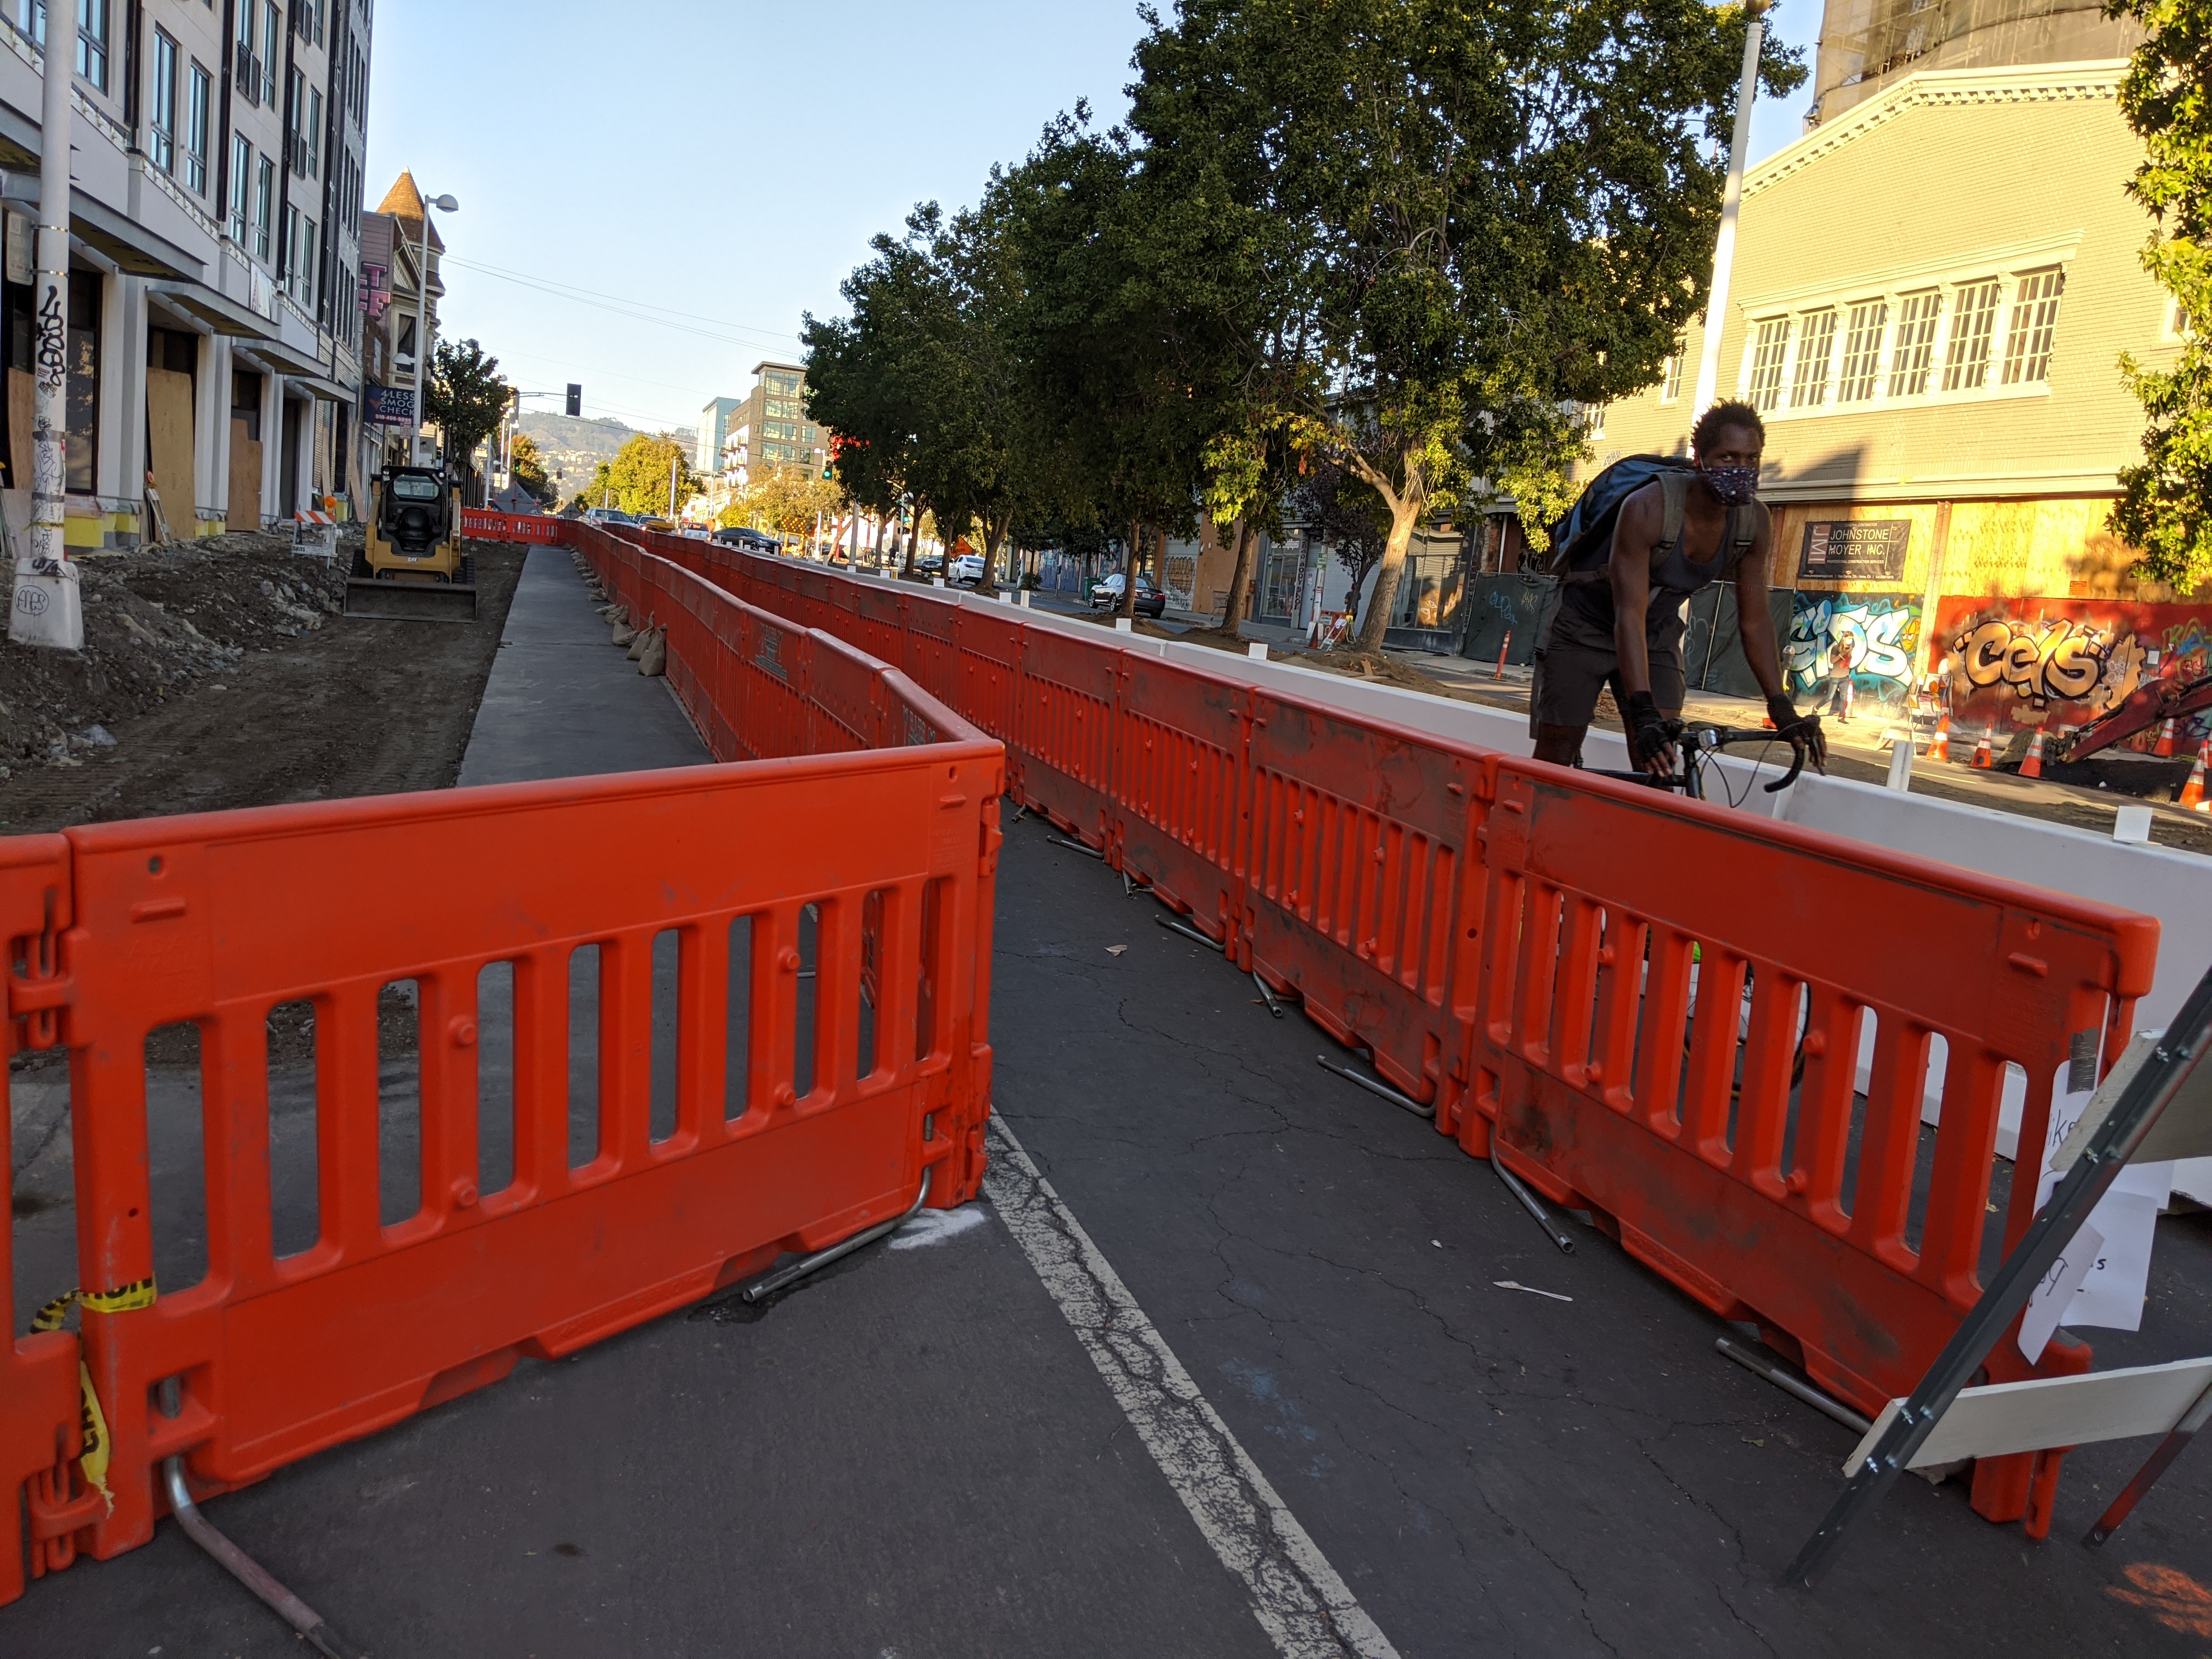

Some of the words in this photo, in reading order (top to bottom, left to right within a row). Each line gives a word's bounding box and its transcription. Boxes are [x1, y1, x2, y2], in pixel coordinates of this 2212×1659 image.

[381, 398, 414, 408] SMOG
[380, 406, 414, 416] CHECK
[1830, 529, 1889, 540] JOHNSTONE
[1809, 527, 1829, 561] JMI
